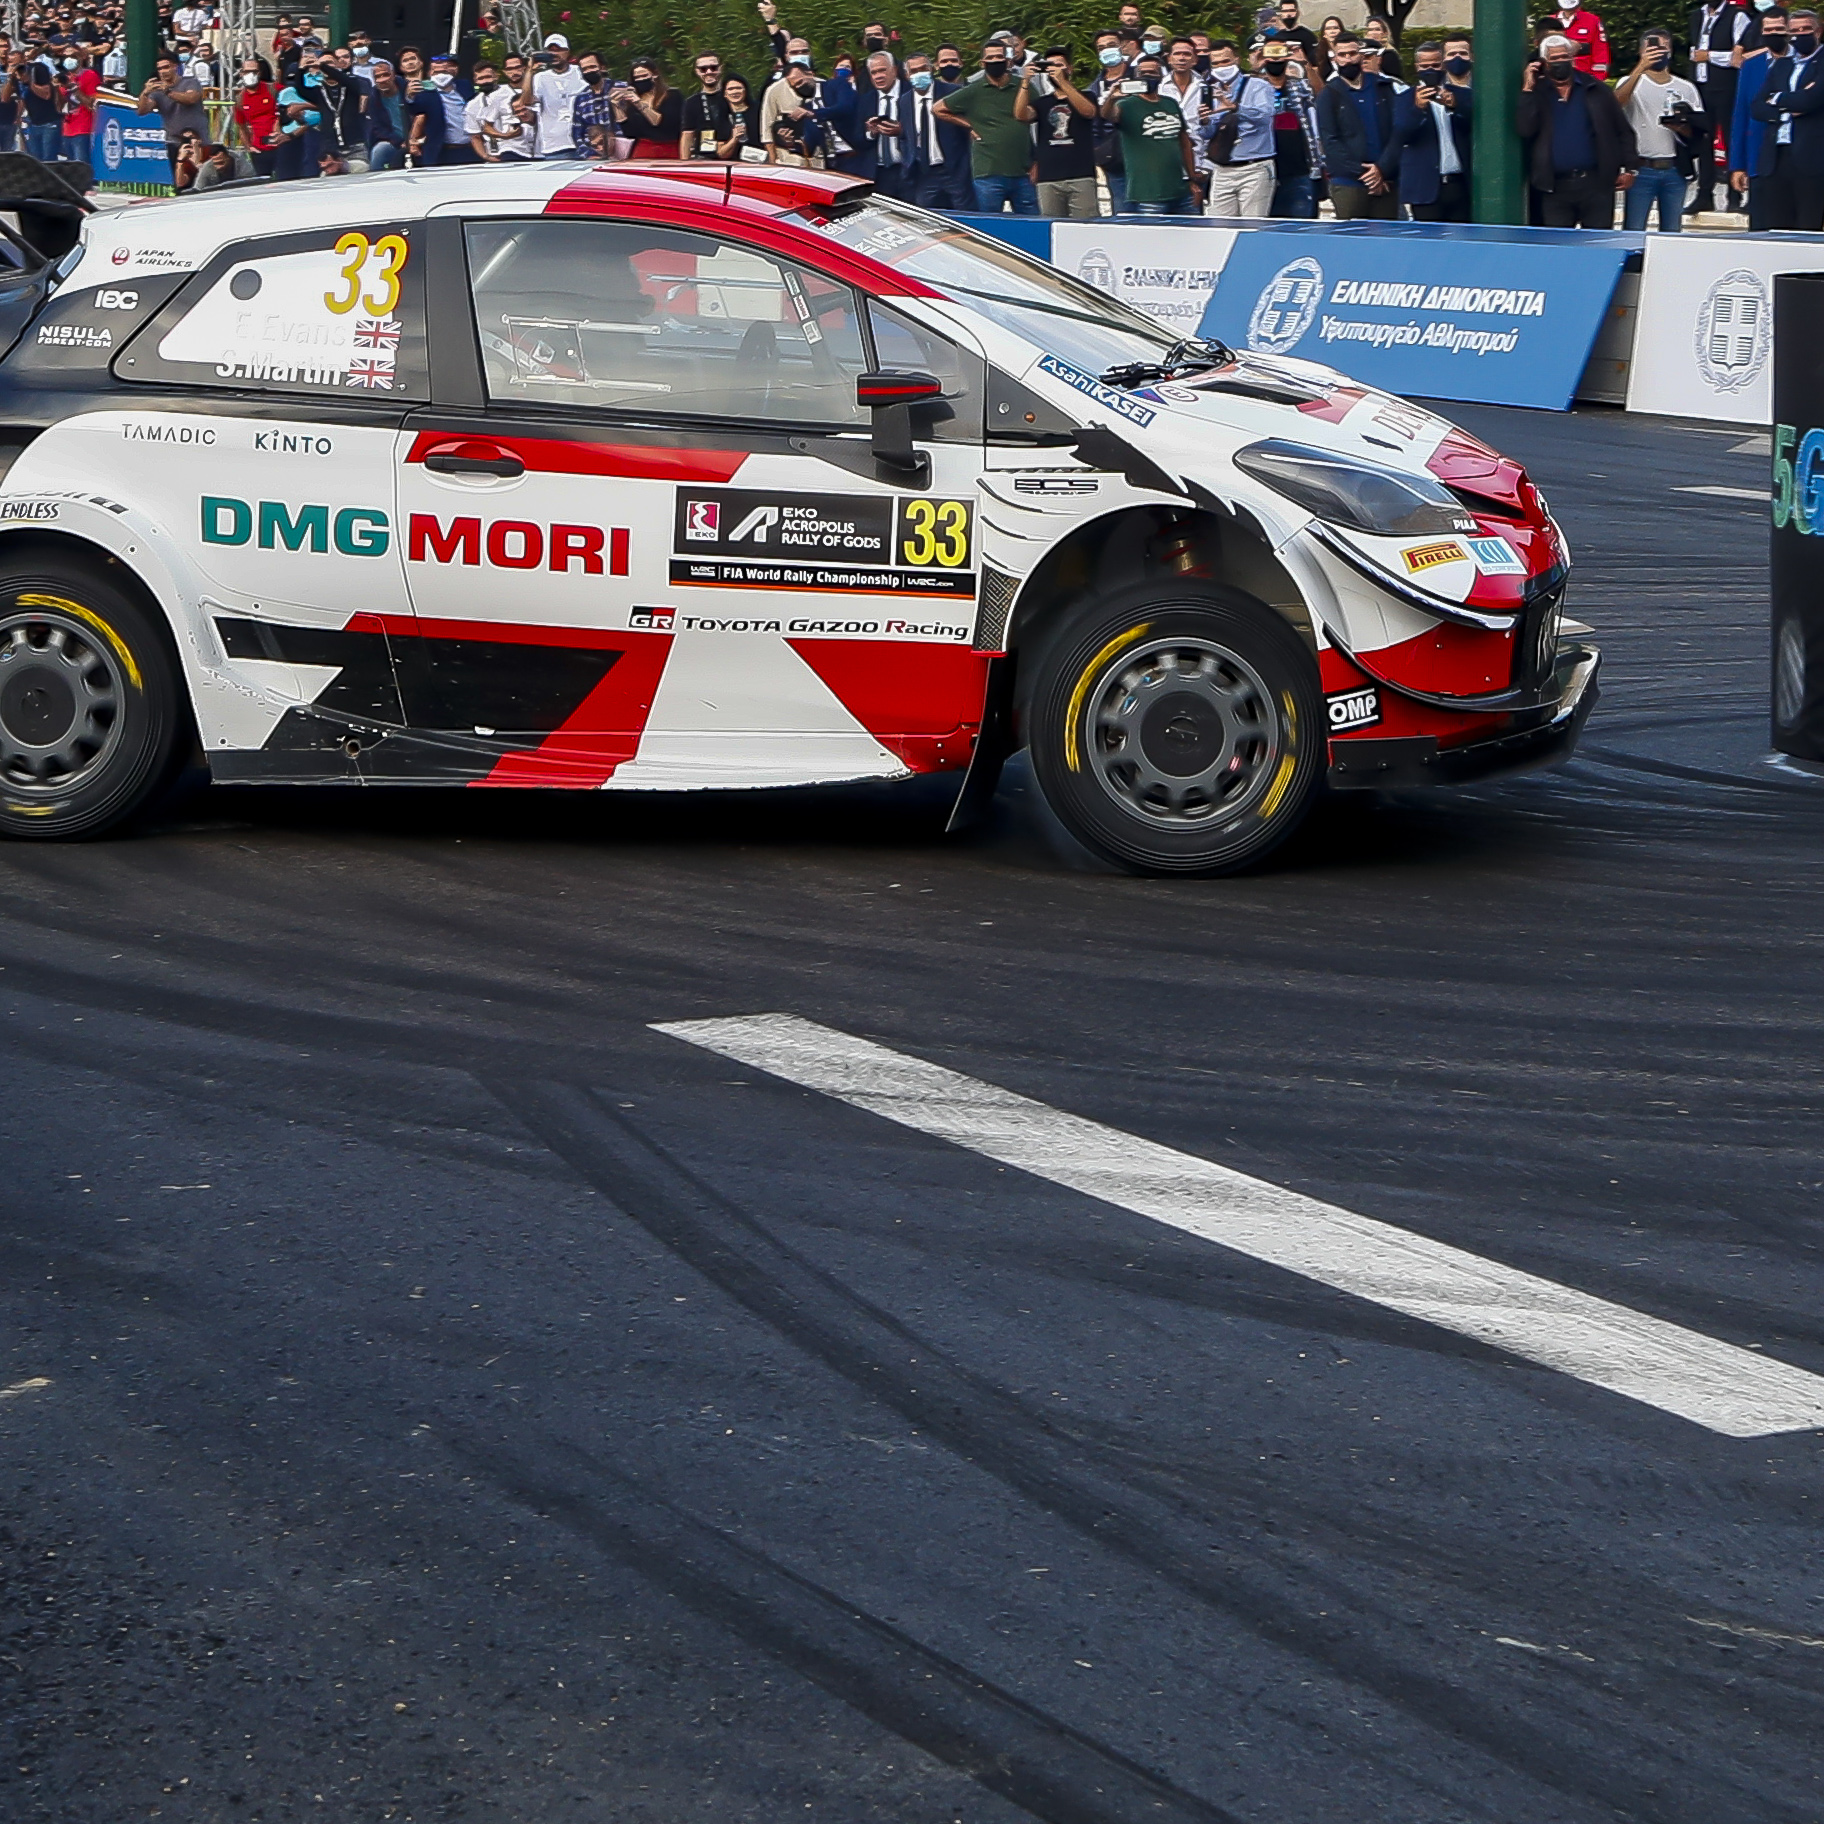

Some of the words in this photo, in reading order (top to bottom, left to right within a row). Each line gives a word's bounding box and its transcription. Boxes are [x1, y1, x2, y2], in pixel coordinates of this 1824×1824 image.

[135, 249, 175, 257] JAPAN
[135, 258, 193, 268] AIRLINES
[324, 232, 410, 317] 33
[1330, 280, 1427, 308] ΕΛΛΗΝΙΚΗ
[1421, 285, 1546, 316] ΔΗΜΟΚΡΑΤΙΑ
[39, 326, 112, 339] NISULA
[121, 423, 217, 445] TAMADIC
[0, 502, 60, 519] ENDLESS
[782, 507, 818, 519] EKO
[201, 495, 390, 557] DMG
[408, 512, 631, 577] MORI
[694, 531, 717, 539] EKO
[781, 519, 855, 535] ACROPOLIS
[904, 499, 967, 567] 33
[781, 532, 822, 547] RALLY
[822, 534, 841, 547] OF
[843, 535, 881, 550] GODS
[1406, 543, 1463, 569] PIRELLI
[723, 567, 744, 580] FIA
[746, 567, 781, 581] World
[784, 570, 814, 585] Rally
[816, 571, 900, 589] Championship
[632, 614, 674, 630] GR
[682, 617, 781, 633] TOYOTA
[788, 618, 879, 634] GAZOO
[885, 619, 970, 642] Racing
[1328, 694, 1377, 723] OMP
